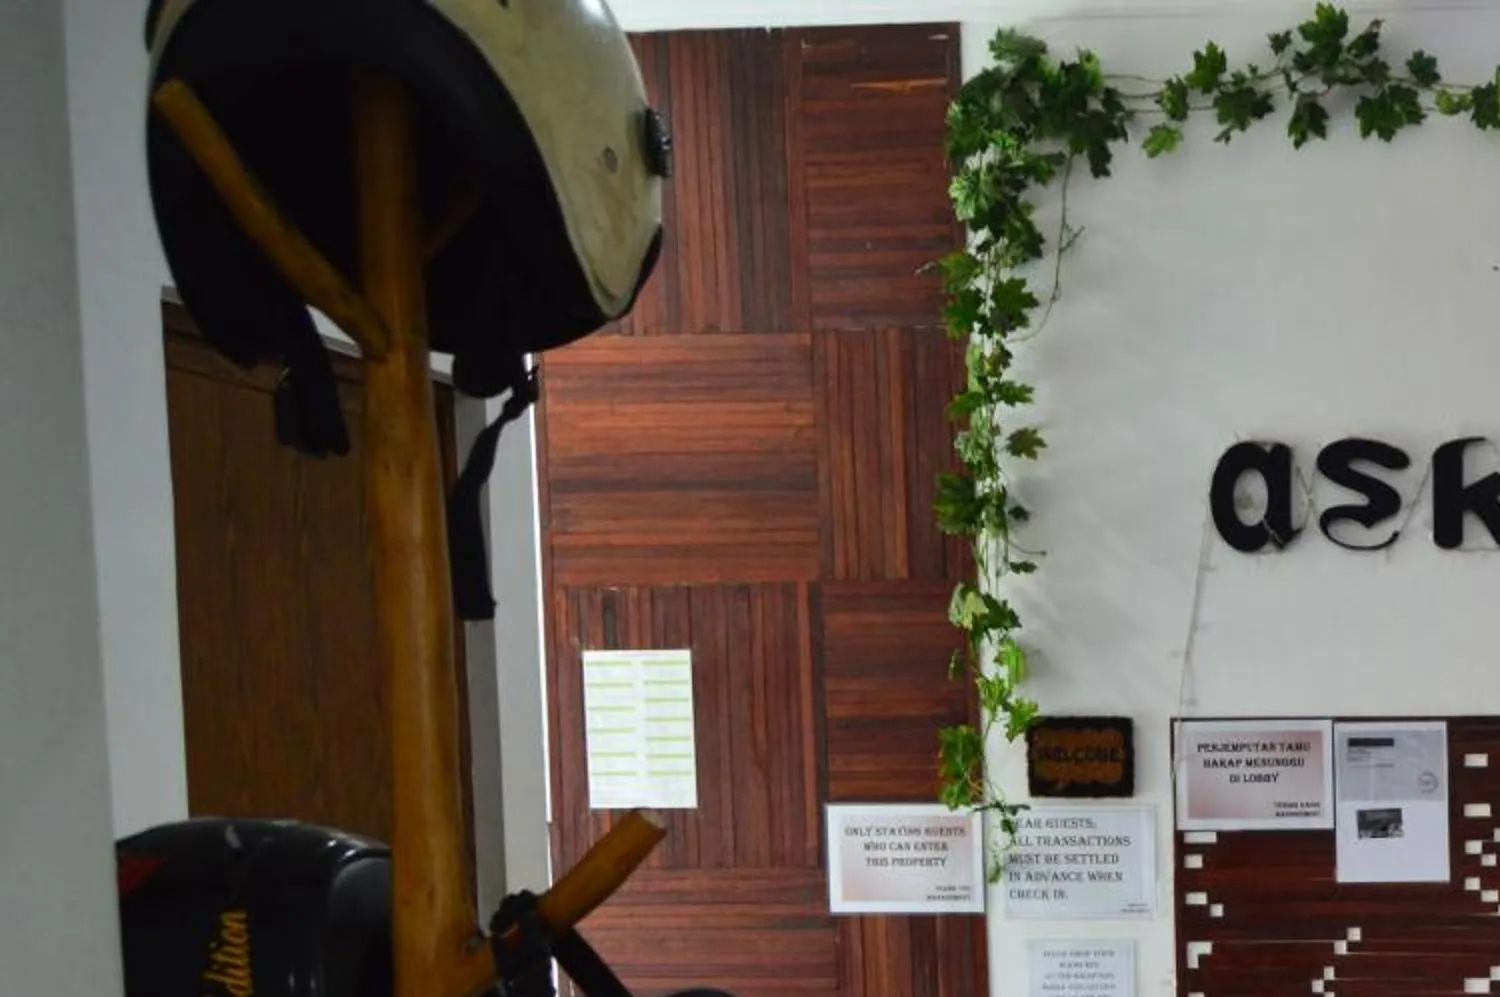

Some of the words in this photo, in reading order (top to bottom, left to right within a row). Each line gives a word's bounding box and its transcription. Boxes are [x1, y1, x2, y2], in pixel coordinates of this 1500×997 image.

[1278, 742, 1311, 752] TAMU
[1203, 759, 1242, 768] HARAP
[1229, 774, 1240, 783] DI
[1243, 773, 1279, 783] LOBBY
[1009, 817, 1042, 829] EAR
[844, 826, 871, 837] ONLY
[863, 842, 886, 851] WHO
[888, 842, 910, 851] CAN
[913, 842, 949, 851] ENTER
[1009, 835, 1033, 846] ALL
[1036, 835, 1132, 847] TRANSACTIONS
[866, 857, 888, 867] THIS
[891, 857, 947, 867] PROPERTY
[1008, 853, 1040, 864] MUST
[1044, 853, 1062, 864] BE
[1063, 853, 1119, 865] SETTLED
[1009, 871, 1021, 881] IN
[1025, 871, 1084, 882] ADVANCE
[1087, 872, 1123, 882] WHEN
[1009, 888, 1049, 899] CHECK
